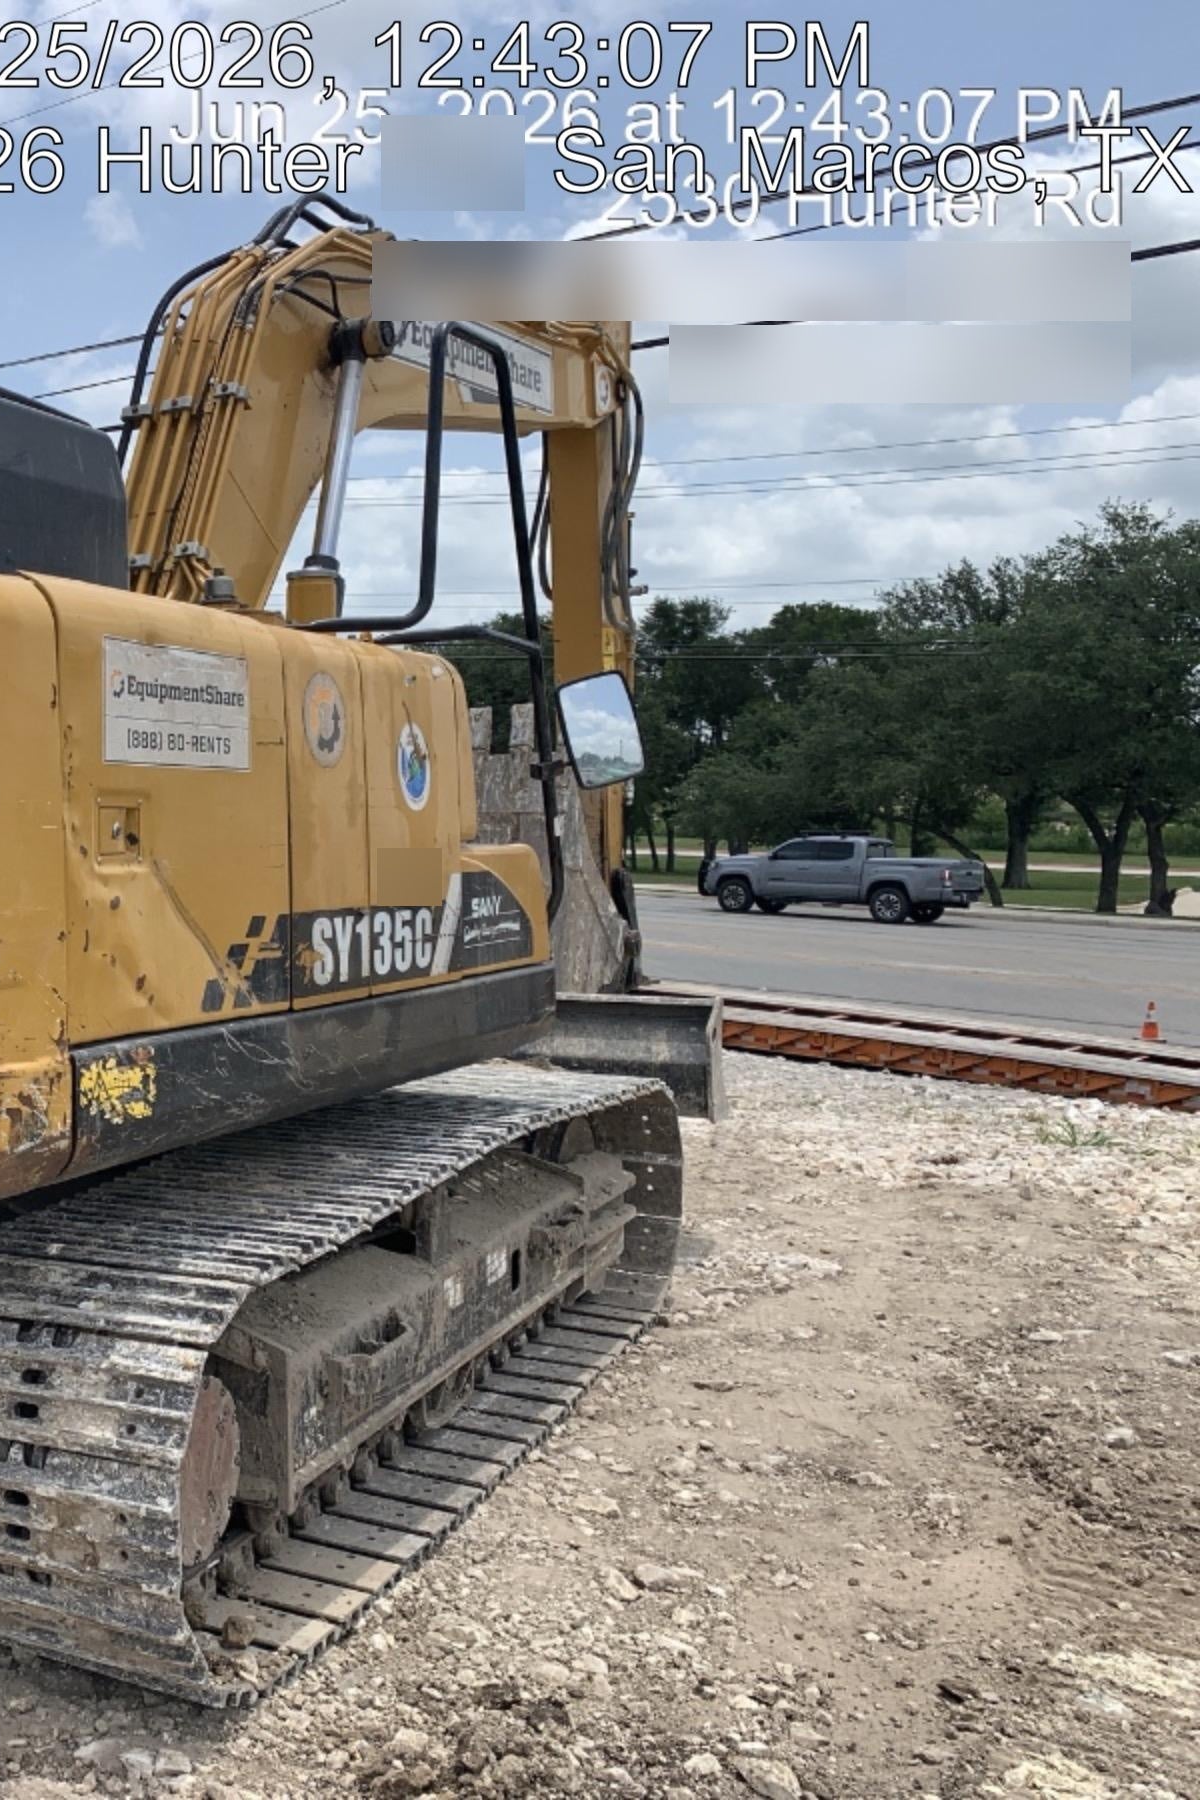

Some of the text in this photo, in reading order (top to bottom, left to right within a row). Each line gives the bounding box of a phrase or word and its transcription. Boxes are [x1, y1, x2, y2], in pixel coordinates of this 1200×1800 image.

[127, 675, 245, 707] EquipmentShare
[127, 728, 231, 755] (888) 80-RENTS
[311, 907, 433, 986] SY135C
